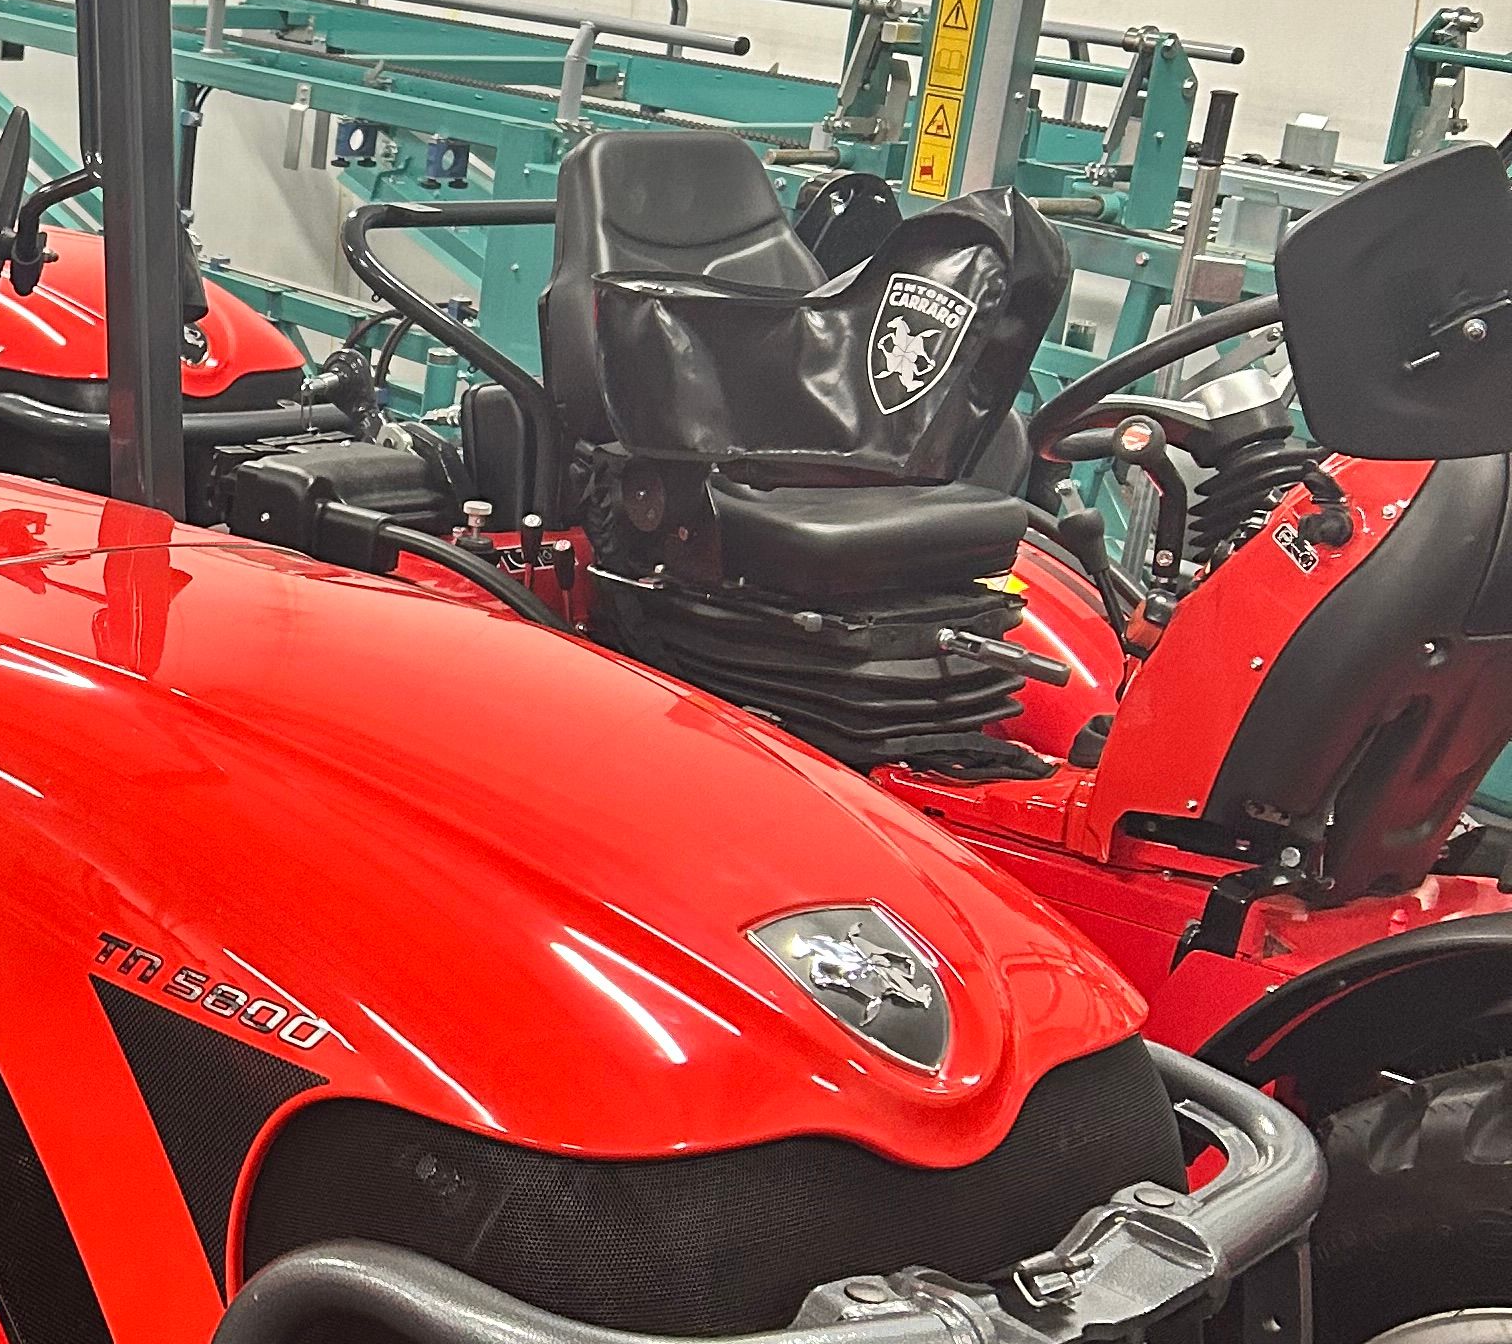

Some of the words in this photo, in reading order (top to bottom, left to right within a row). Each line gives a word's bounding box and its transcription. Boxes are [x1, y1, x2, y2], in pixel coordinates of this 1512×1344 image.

[889, 291, 960, 329] CARRARO
[892, 282, 968, 316] ANTONIO
[163, 965, 331, 1050] 5800
